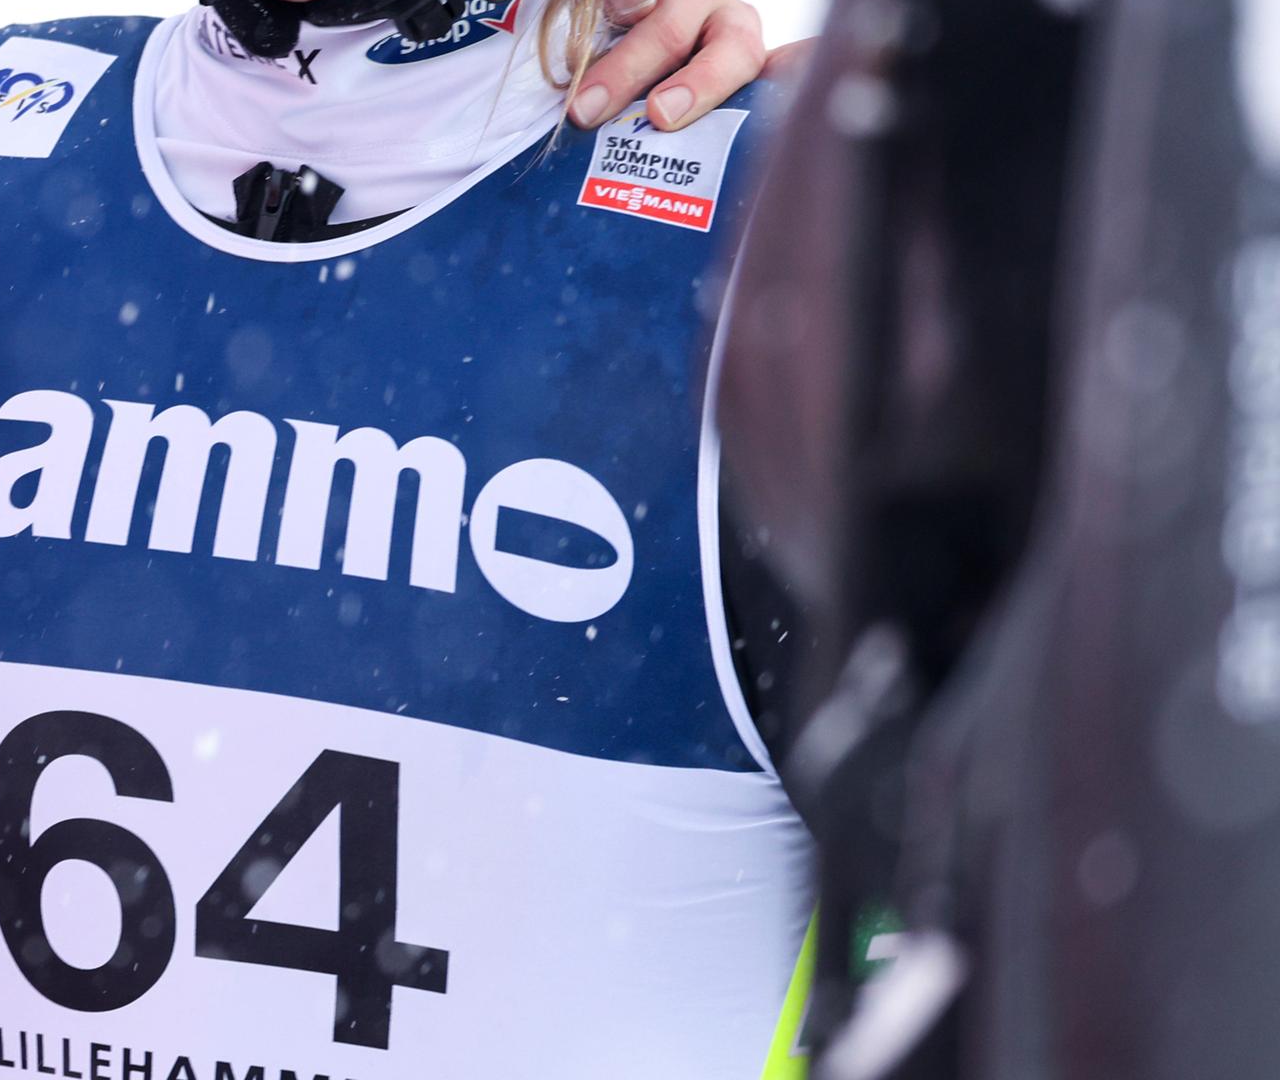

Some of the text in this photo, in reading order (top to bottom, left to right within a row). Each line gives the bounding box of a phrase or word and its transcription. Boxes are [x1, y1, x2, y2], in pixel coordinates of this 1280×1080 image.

[605, 135, 643, 151] SKI
[600, 161, 695, 187] WORLD CUP
[603, 149, 702, 176] JUMPING
[593, 184, 705, 218] VIESSMANN
